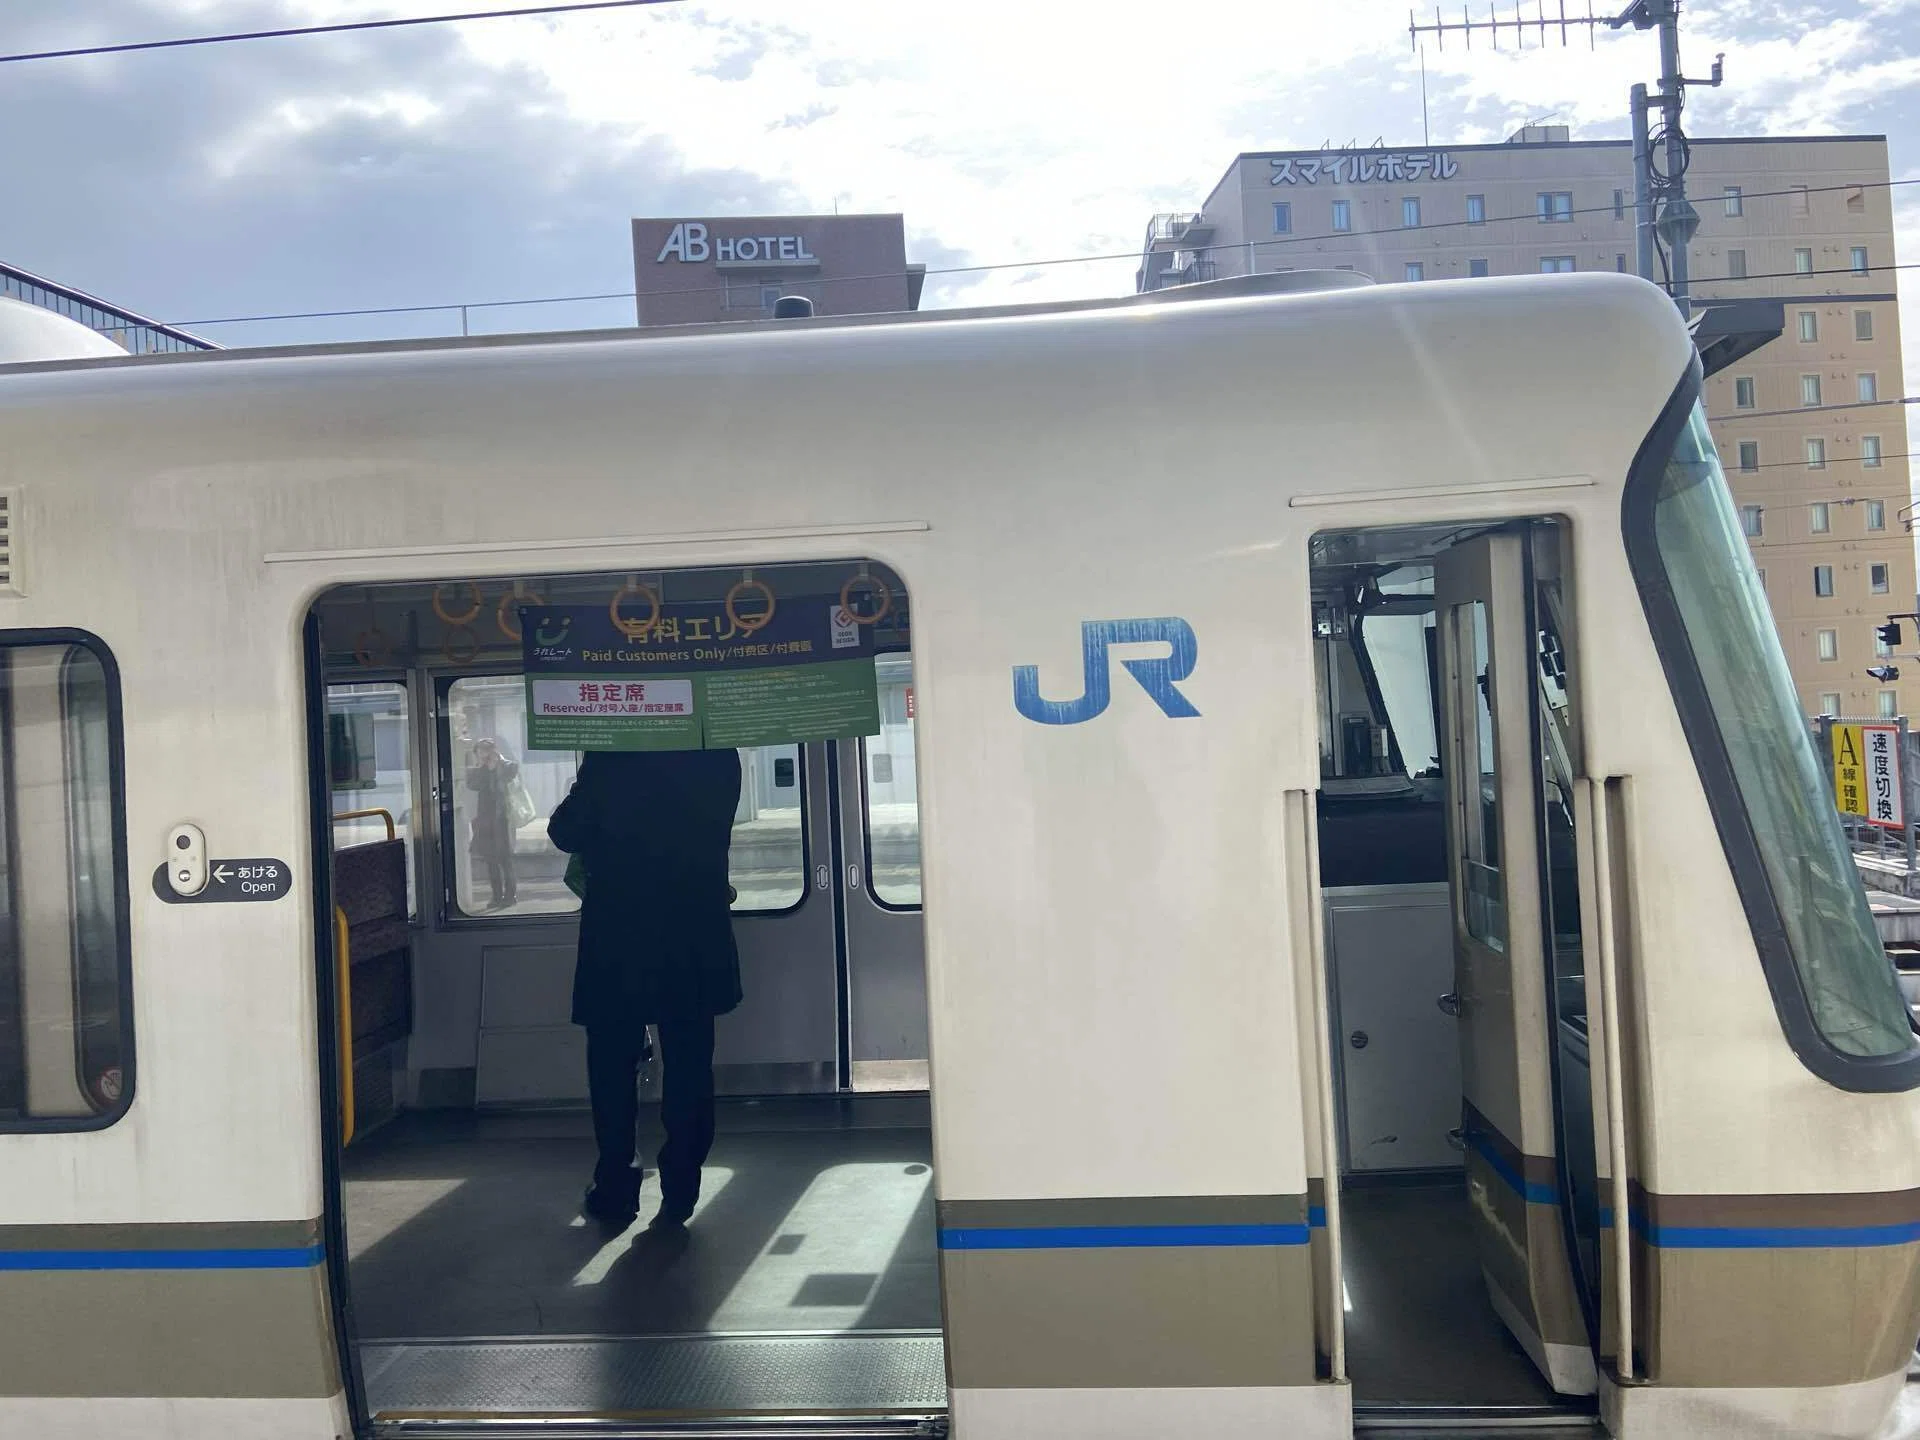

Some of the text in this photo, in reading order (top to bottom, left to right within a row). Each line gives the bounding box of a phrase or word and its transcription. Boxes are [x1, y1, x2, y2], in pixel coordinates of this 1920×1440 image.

[1271, 153, 1458, 185] スマイルホテル
[657, 223, 814, 263] AB HOTEL
[582, 649, 612, 662] Paid
[616, 649, 690, 662] Customers
[1012, 616, 1203, 725] JR
[579, 683, 645, 702] 指定席
[1873, 733, 1892, 820] 速度切換
[238, 865, 278, 879] あける
[241, 881, 276, 894] Open
